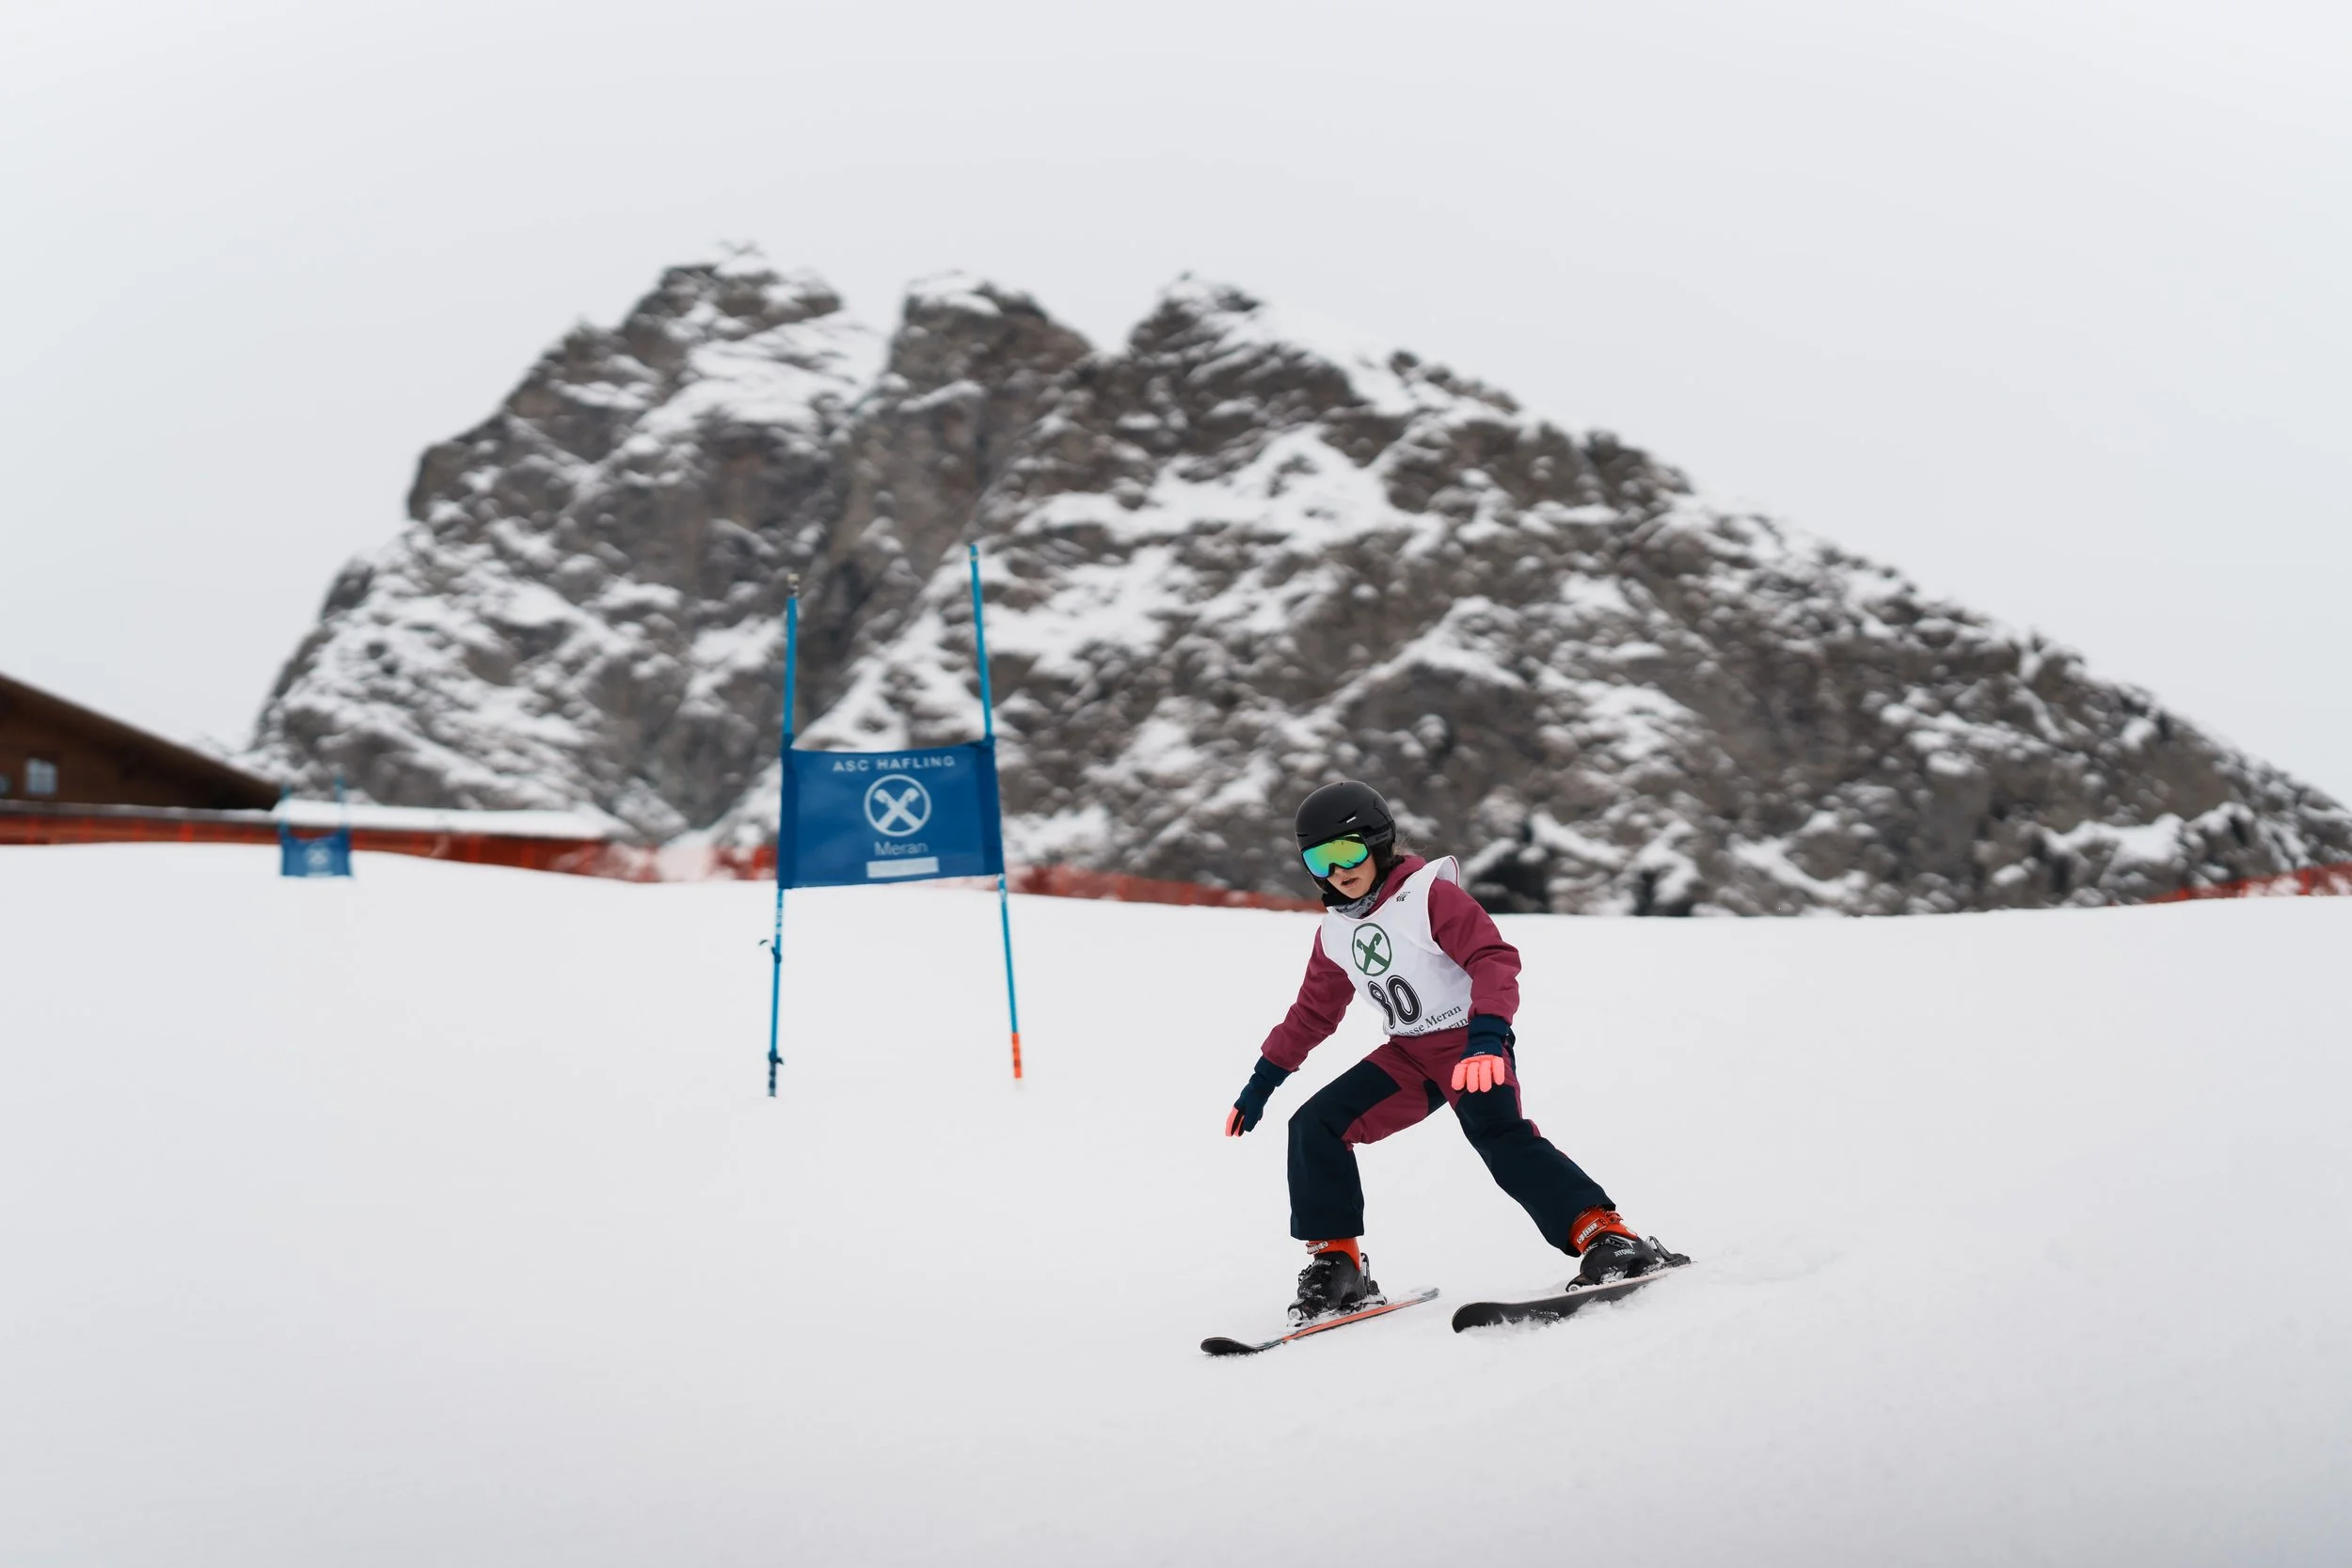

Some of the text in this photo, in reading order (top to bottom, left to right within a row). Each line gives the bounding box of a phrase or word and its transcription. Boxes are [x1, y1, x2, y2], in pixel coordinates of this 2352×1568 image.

[833, 755, 956, 771] ASC HAFLING
[874, 841, 929, 856] Meran
[1425, 1006, 1462, 1028] Meran
